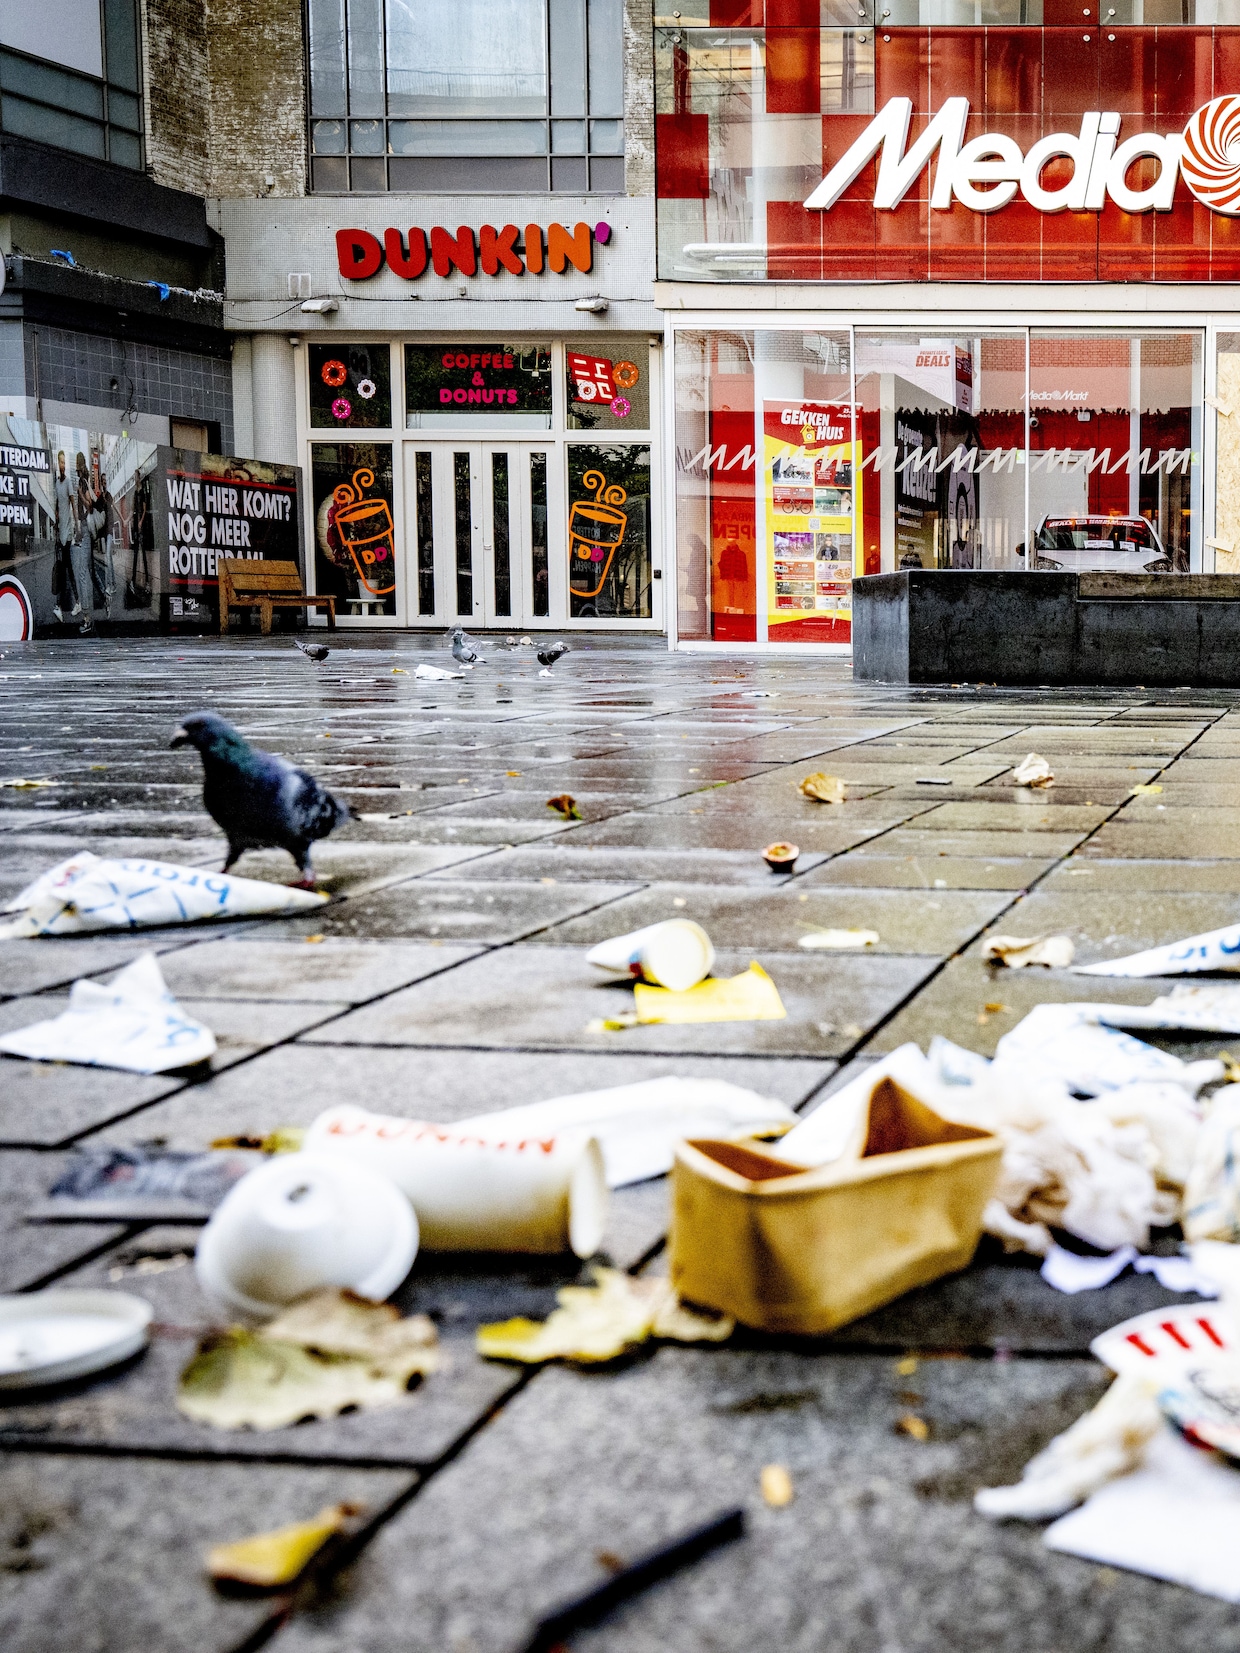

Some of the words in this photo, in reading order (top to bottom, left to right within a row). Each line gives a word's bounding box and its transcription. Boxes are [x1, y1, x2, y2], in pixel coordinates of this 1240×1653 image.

[803, 96, 1184, 212] Media
[335, 221, 612, 280] DUNKIN'
[441, 353, 515, 370] COFFEE
[915, 355, 951, 368] DEALS
[471, 371, 486, 387] &
[438, 387, 518, 405] DONUTS
[780, 408, 830, 427] GEKKEN
[816, 425, 845, 441] HUIS
[18, 477, 29, 496] IT
[166, 478, 200, 511] WAT
[205, 484, 240, 516] HIER
[243, 489, 292, 521] KOMT?
[168, 511, 207, 544] NOG
[211, 516, 252, 547] MEER
[169, 545, 265, 577] ROTTE
